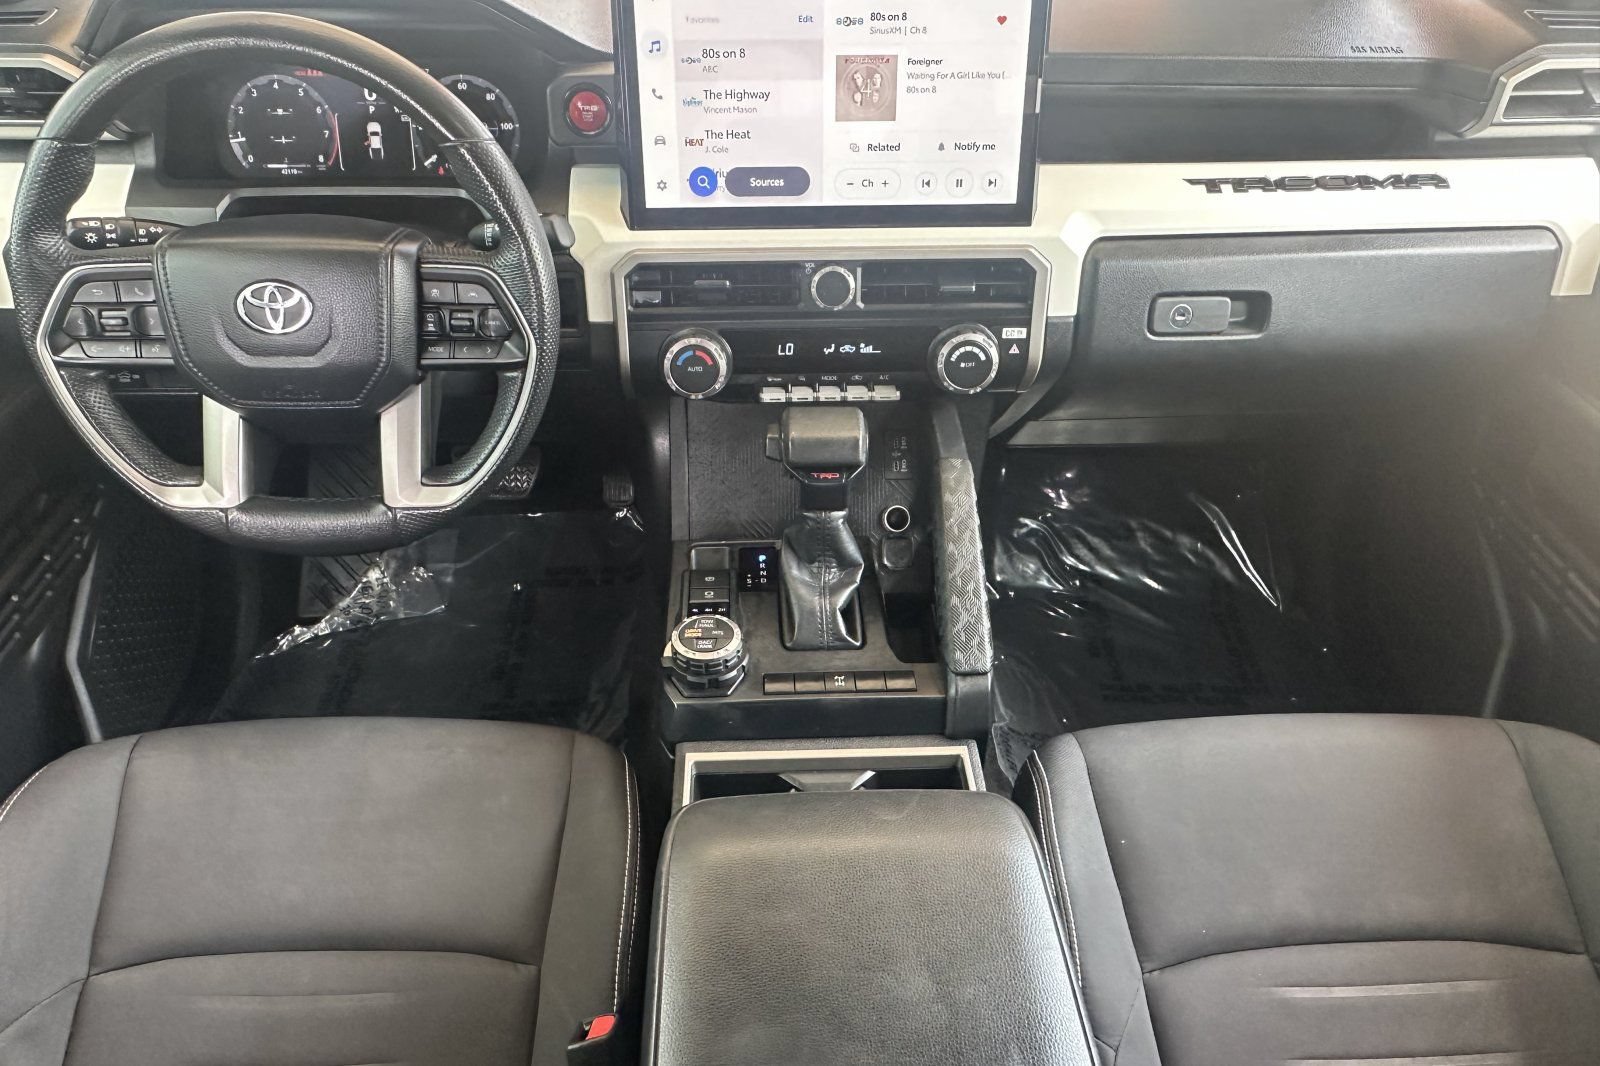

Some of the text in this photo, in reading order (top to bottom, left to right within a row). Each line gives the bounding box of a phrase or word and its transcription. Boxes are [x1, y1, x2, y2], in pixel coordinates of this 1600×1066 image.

[798, 15, 814, 23] Edit
[870, 12, 886, 21] 80s
[901, 12, 908, 21] 8
[910, 26, 920, 34] Ch
[921, 26, 928, 34] 8
[702, 48, 746, 58] 80s on 8
[907, 58, 943, 67] Foreigner
[906, 72, 935, 81] Waiting
[936, 72, 949, 80] For
[949, 72, 956, 80] A
[957, 72, 970, 80] Girl
[971, 72, 985, 80] Like
[987, 72, 1001, 80] You
[272, 82, 279, 90] 4
[457, 82, 467, 90] 60
[906, 86, 919, 94] 80s
[931, 86, 937, 94] 8
[251, 89, 257, 97] 3
[298, 88, 304, 97] 5
[485, 92, 496, 101] 80
[703, 89, 771, 102] The Highway
[238, 106, 244, 114] 2
[316, 106, 322, 114] 6
[369, 105, 376, 115] P
[703, 106, 758, 114] Vincent Mason
[500, 122, 514, 131] 100
[324, 130, 330, 139] 7
[704, 129, 752, 140] The Heat
[684, 138, 704, 147] HEAT
[867, 142, 901, 152] Related
[954, 141, 996, 153] Notify me
[711, 145, 729, 154] Cole
[248, 154, 254, 163] 0
[318, 154, 325, 163] 8
[750, 176, 785, 187] Sources
[861, 178, 874, 188] Ch
[1182, 173, 1451, 194] TACOMA
[777, 342, 794, 356] LO
